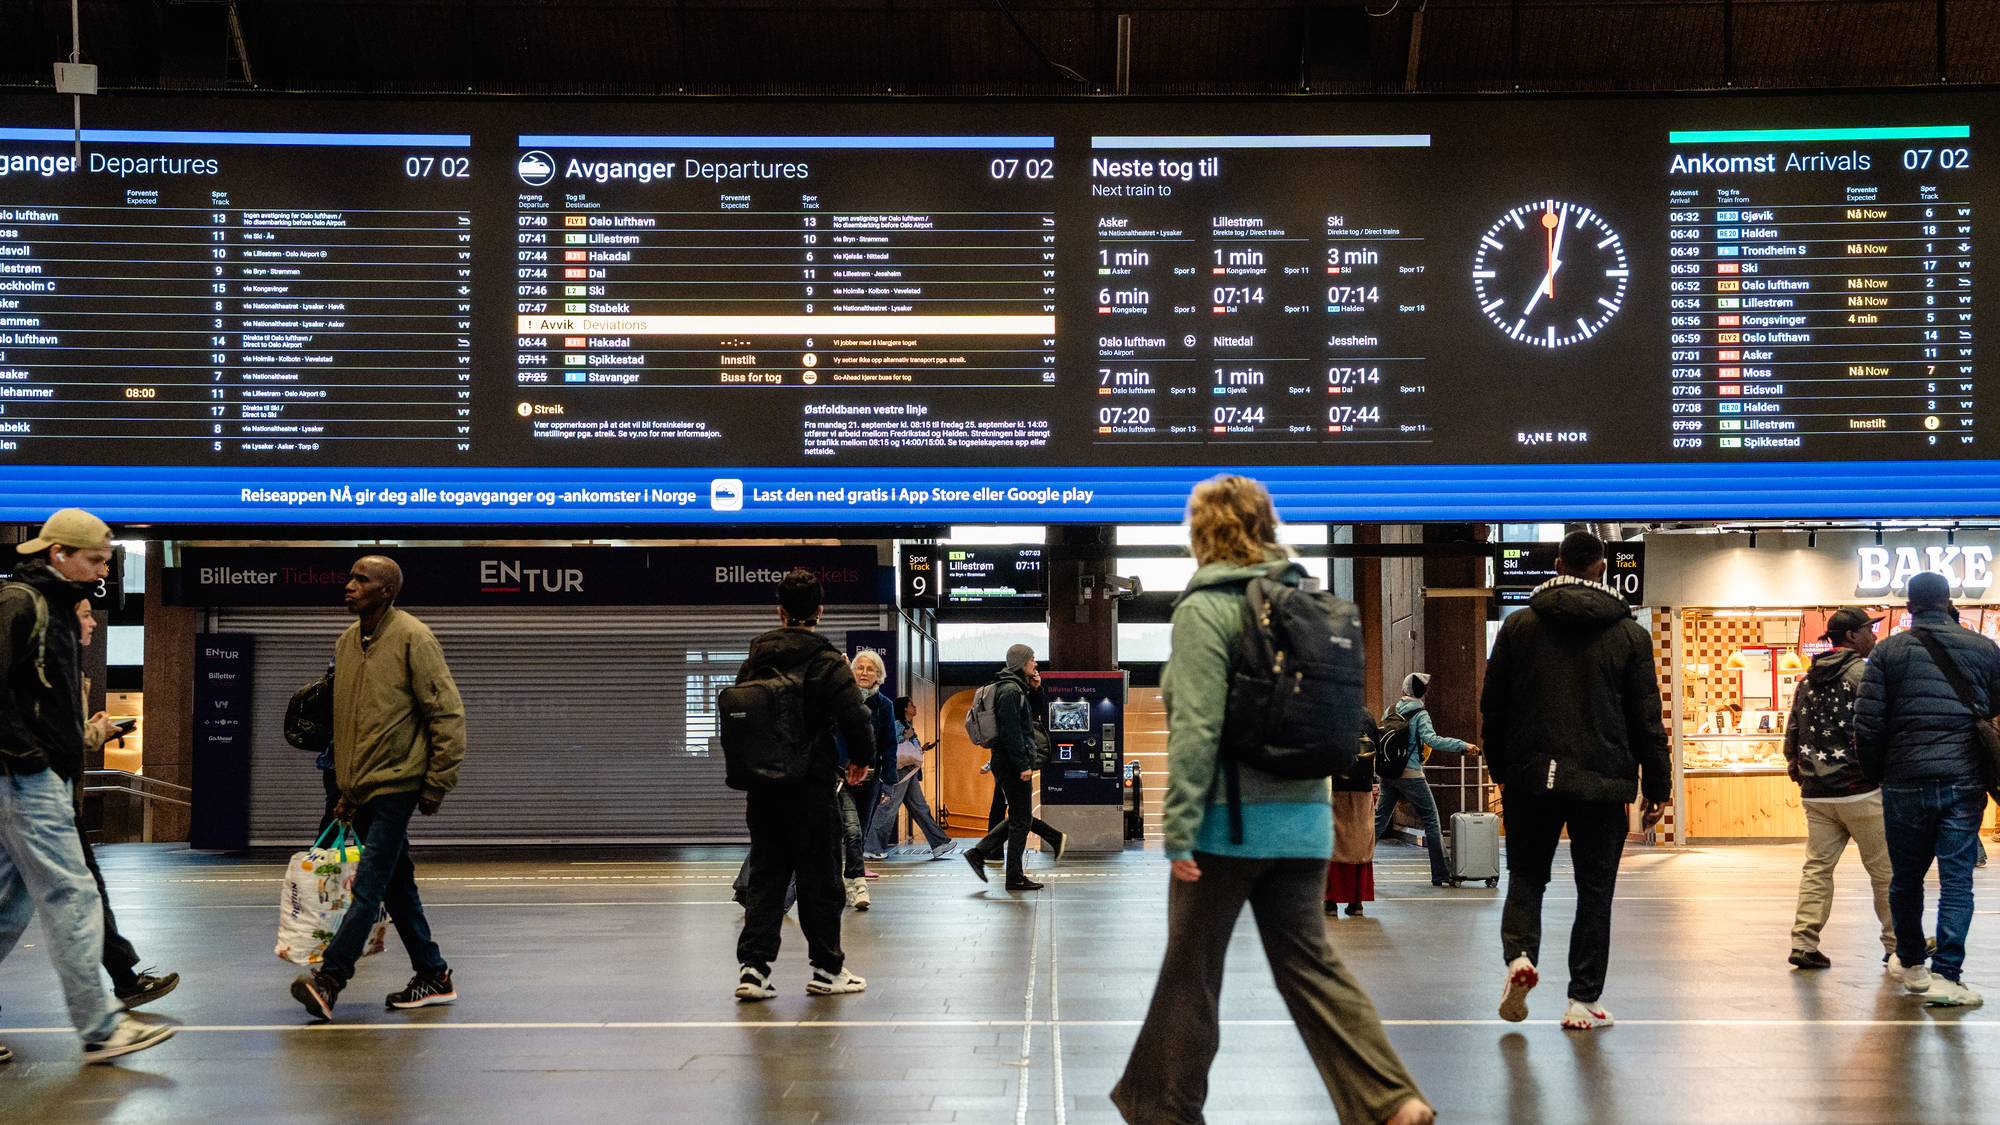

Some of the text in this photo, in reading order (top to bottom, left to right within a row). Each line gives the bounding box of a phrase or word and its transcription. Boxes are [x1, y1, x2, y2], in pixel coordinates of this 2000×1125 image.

[1670, 151, 1870, 173] Ankomst Arrivals
[1904, 149, 1969, 169] 07 02
[91, 153, 218, 177] Departures
[406, 157, 469, 177] 07 02
[992, 159, 1053, 178] 07 02
[1093, 157, 1217, 181] Neste tog til
[566, 159, 808, 183] Avganger Departures
[1093, 184, 1171, 196] Next train to
[519, 200, 819, 209] Departure Destination Expected Track
[16, 210, 225, 223] lufthavn 13
[1671, 208, 1933, 222] 06:32 Gjøvik Nå Now 6
[519, 216, 816, 226] 07:40 Oslo lufthavn 13
[1099, 216, 1343, 227] Asker Lillestrøm Ski
[213, 231, 224, 240] 11
[519, 234, 816, 243] 07:41 Lillestrøm 10
[1671, 228, 1777, 239] 06:40 Halden
[1671, 244, 1862, 256] 06:49 Trondheim S Nå
[519, 251, 547, 260] 07:44
[589, 251, 630, 261] Hakadal
[806, 252, 813, 261] 6
[1100, 248, 1377, 265] 1 min 1 min 3 min
[519, 269, 547, 278] 07:44
[589, 269, 605, 278] Dal
[804, 270, 815, 278] 11
[1671, 263, 1758, 273] 06:50 Ski
[213, 284, 225, 293] 15
[519, 286, 813, 295] 07:46 Ski 9
[1671, 280, 1809, 291] 06:52 Oslo lufthavn
[1100, 287, 1379, 304] 6 min 07:14 07:14
[518, 303, 813, 313] 07:47 Stabekk 8
[1672, 298, 1793, 308] 06:54 Lillestrøm
[541, 320, 646, 330] Avvik Deviations
[1672, 315, 1806, 326] 06:56 Kongsvinger
[518, 338, 813, 347] 06:44 Hakadal 6
[1099, 336, 1377, 347] Oslo lufthavn Nittedal Jessheim
[589, 355, 755, 366] Spikkestad Innstilt
[588, 372, 781, 384] Stavanger Buss for tog
[1099, 368, 1379, 385] 7 min 1 min 07:14
[1743, 368, 1771, 377] Moss
[126, 388, 155, 397] 08:00
[535, 405, 563, 414] Streik
[805, 405, 927, 416] Østfoldbanen vestre linje
[1100, 407, 1380, 424] 07:20 07:44 07:44
[1518, 432, 1587, 444] BANE NOR
[1744, 437, 1800, 449] Spikkestad
[241, 485, 1093, 505] Reiseappen NÅ gir deg alle togavganger og -ankomster i Norge Last den ned gratis i App Store eller Google play
[1616, 552, 1634, 561] Spor
[950, 562, 1040, 570] Lillestrøm 07:11
[1504, 560, 1517, 568] Ski
[1616, 560, 1636, 568] Track
[1857, 545, 1993, 589] BAKE
[201, 567, 277, 584] Billetter
[480, 560, 583, 593] ENTUR
[715, 566, 790, 582] Billetter
[94, 578, 106, 597] 3
[913, 576, 926, 596] 9
[1612, 574, 1638, 594] 10
[206, 648, 238, 659] ENTUR
